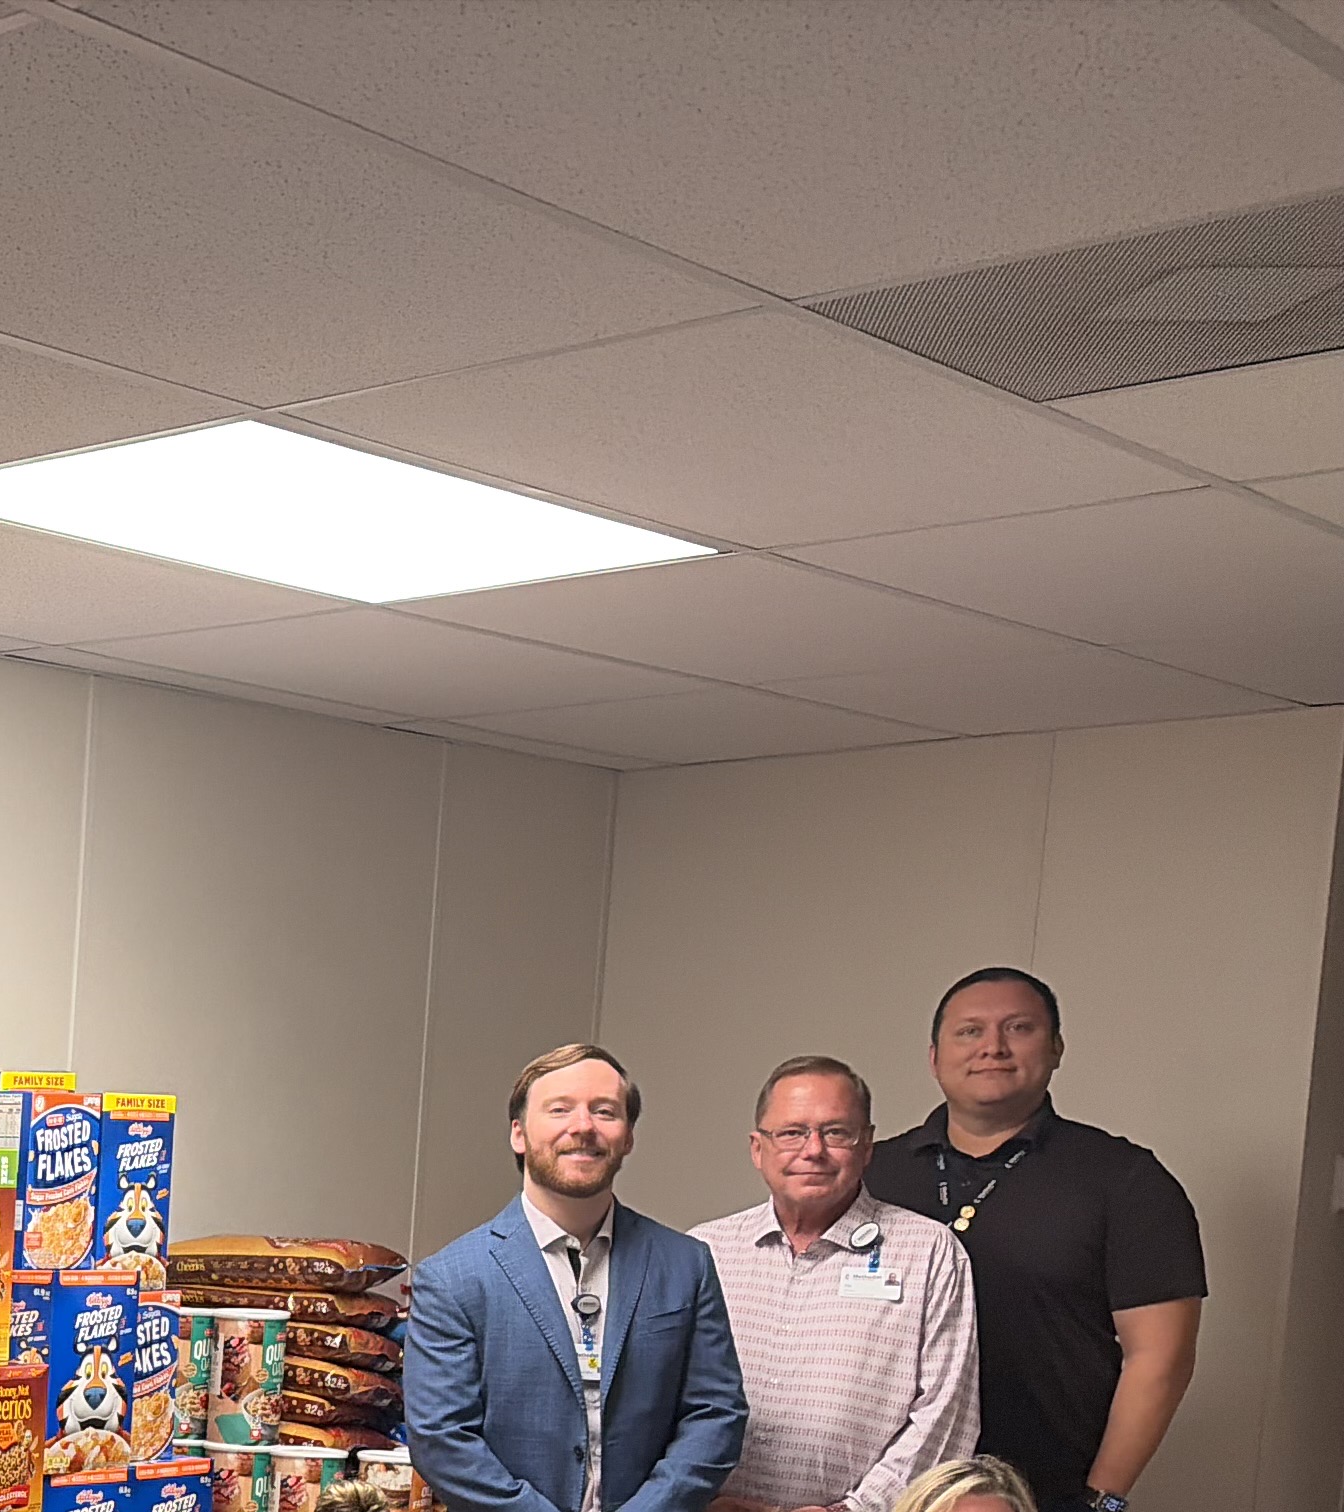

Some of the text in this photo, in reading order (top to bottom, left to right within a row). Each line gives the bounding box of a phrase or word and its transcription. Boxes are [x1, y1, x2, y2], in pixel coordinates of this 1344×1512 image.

[13, 1075, 64, 1086] FAMILY SIZE
[116, 1097, 166, 1108] FAMILY SIZE
[36, 1120, 90, 1151] FROSTED
[117, 1138, 163, 1158] FROSTED
[37, 1148, 90, 1180] FLAKES
[118, 1152, 158, 1172] FLAKES
[75, 1305, 122, 1328] FROSTED
[78, 1320, 118, 1342] FLAKES
